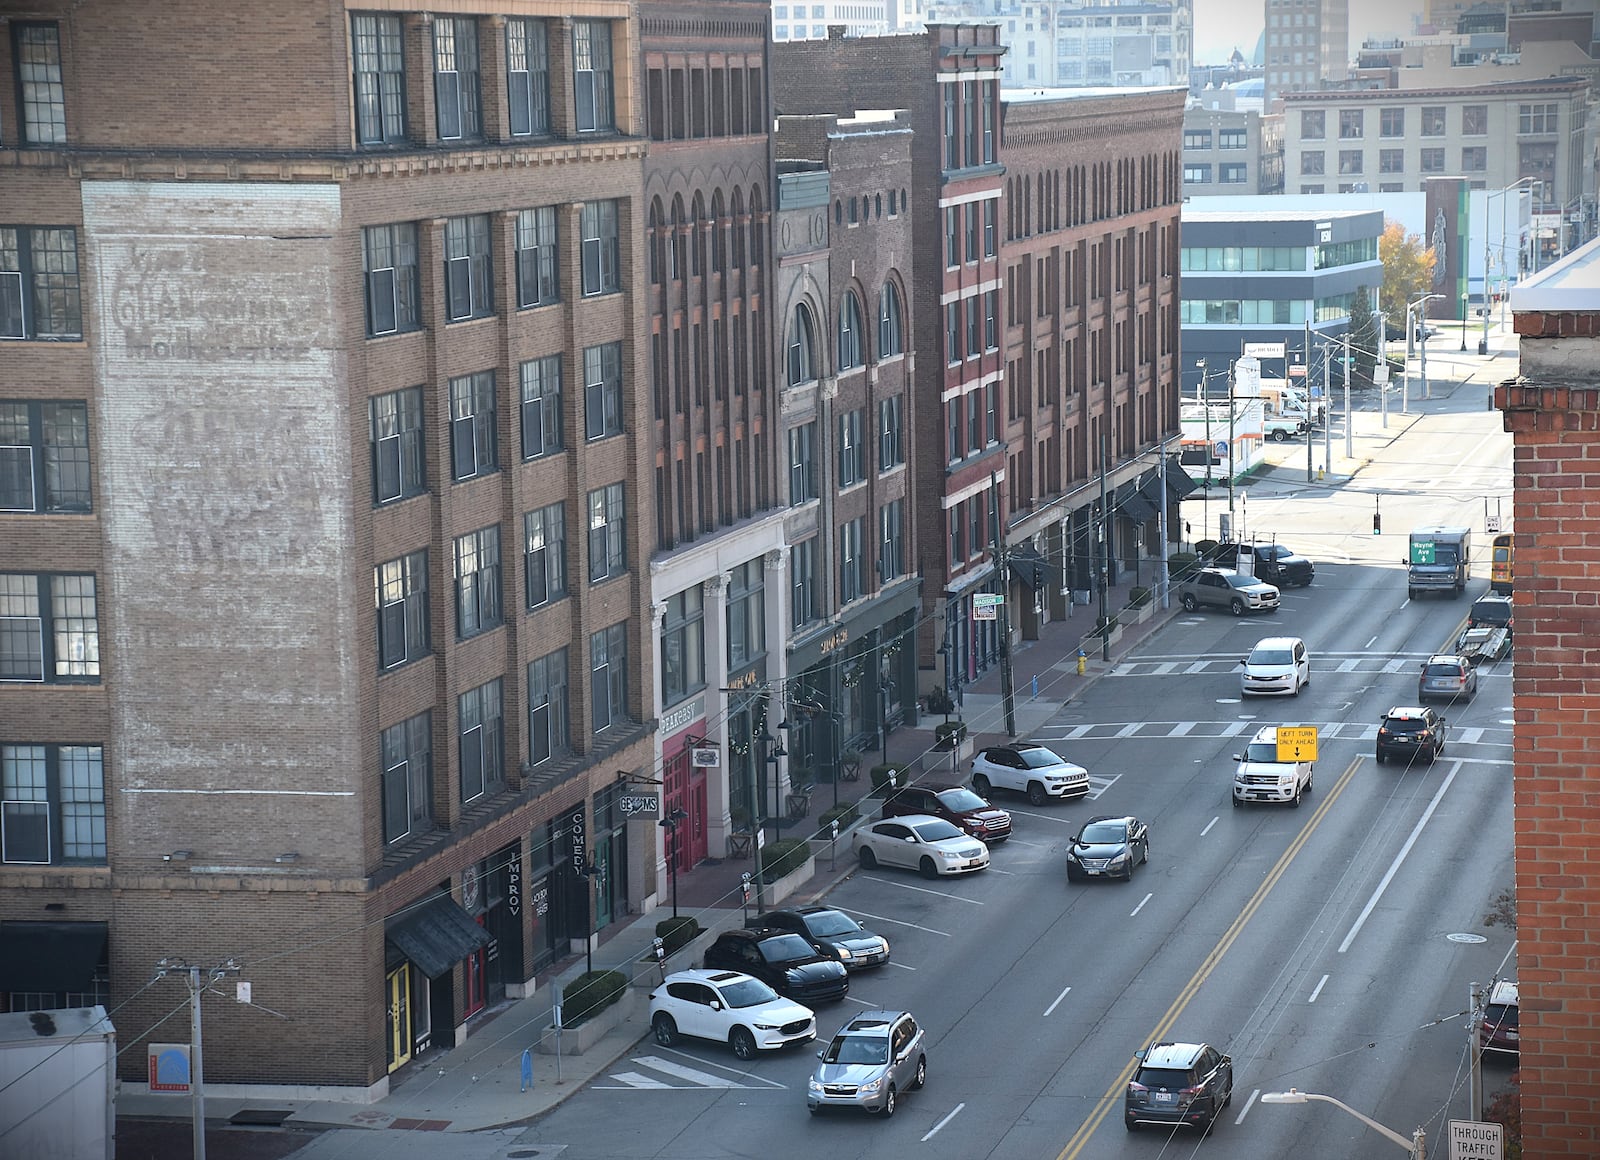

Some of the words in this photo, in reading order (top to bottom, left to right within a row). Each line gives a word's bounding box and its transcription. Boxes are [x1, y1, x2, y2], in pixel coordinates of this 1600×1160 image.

[572, 813, 585, 875] COMEDY
[508, 852, 520, 916] IMPROV
[1453, 1127, 1499, 1141] THROUGH
[1457, 1142, 1495, 1155] TRAFFIC
